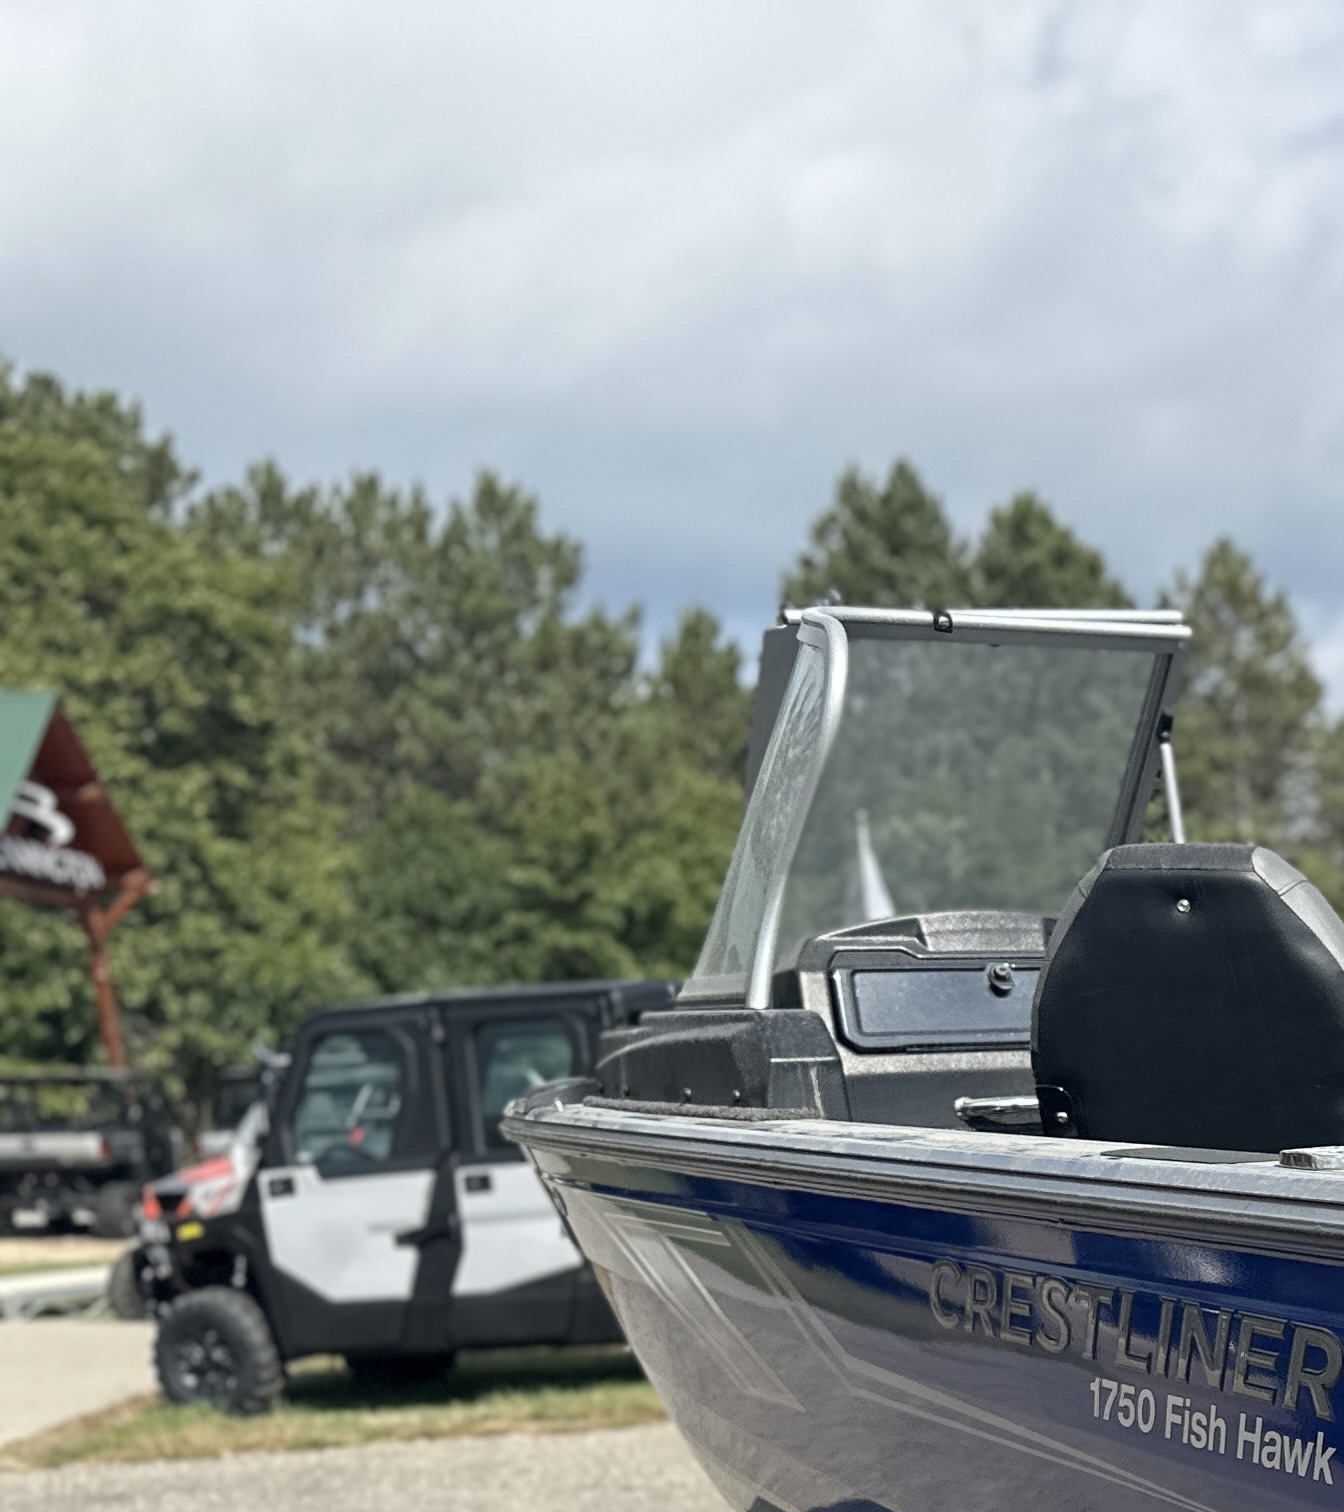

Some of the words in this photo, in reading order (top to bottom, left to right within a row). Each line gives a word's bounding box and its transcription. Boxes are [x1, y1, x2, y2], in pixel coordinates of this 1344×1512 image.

[930, 1258, 1343, 1421] CRESTLINER
[1090, 1376, 1156, 1434] 1750
[1164, 1394, 1227, 1455] Fish
[1236, 1412, 1337, 1485] Hawk
